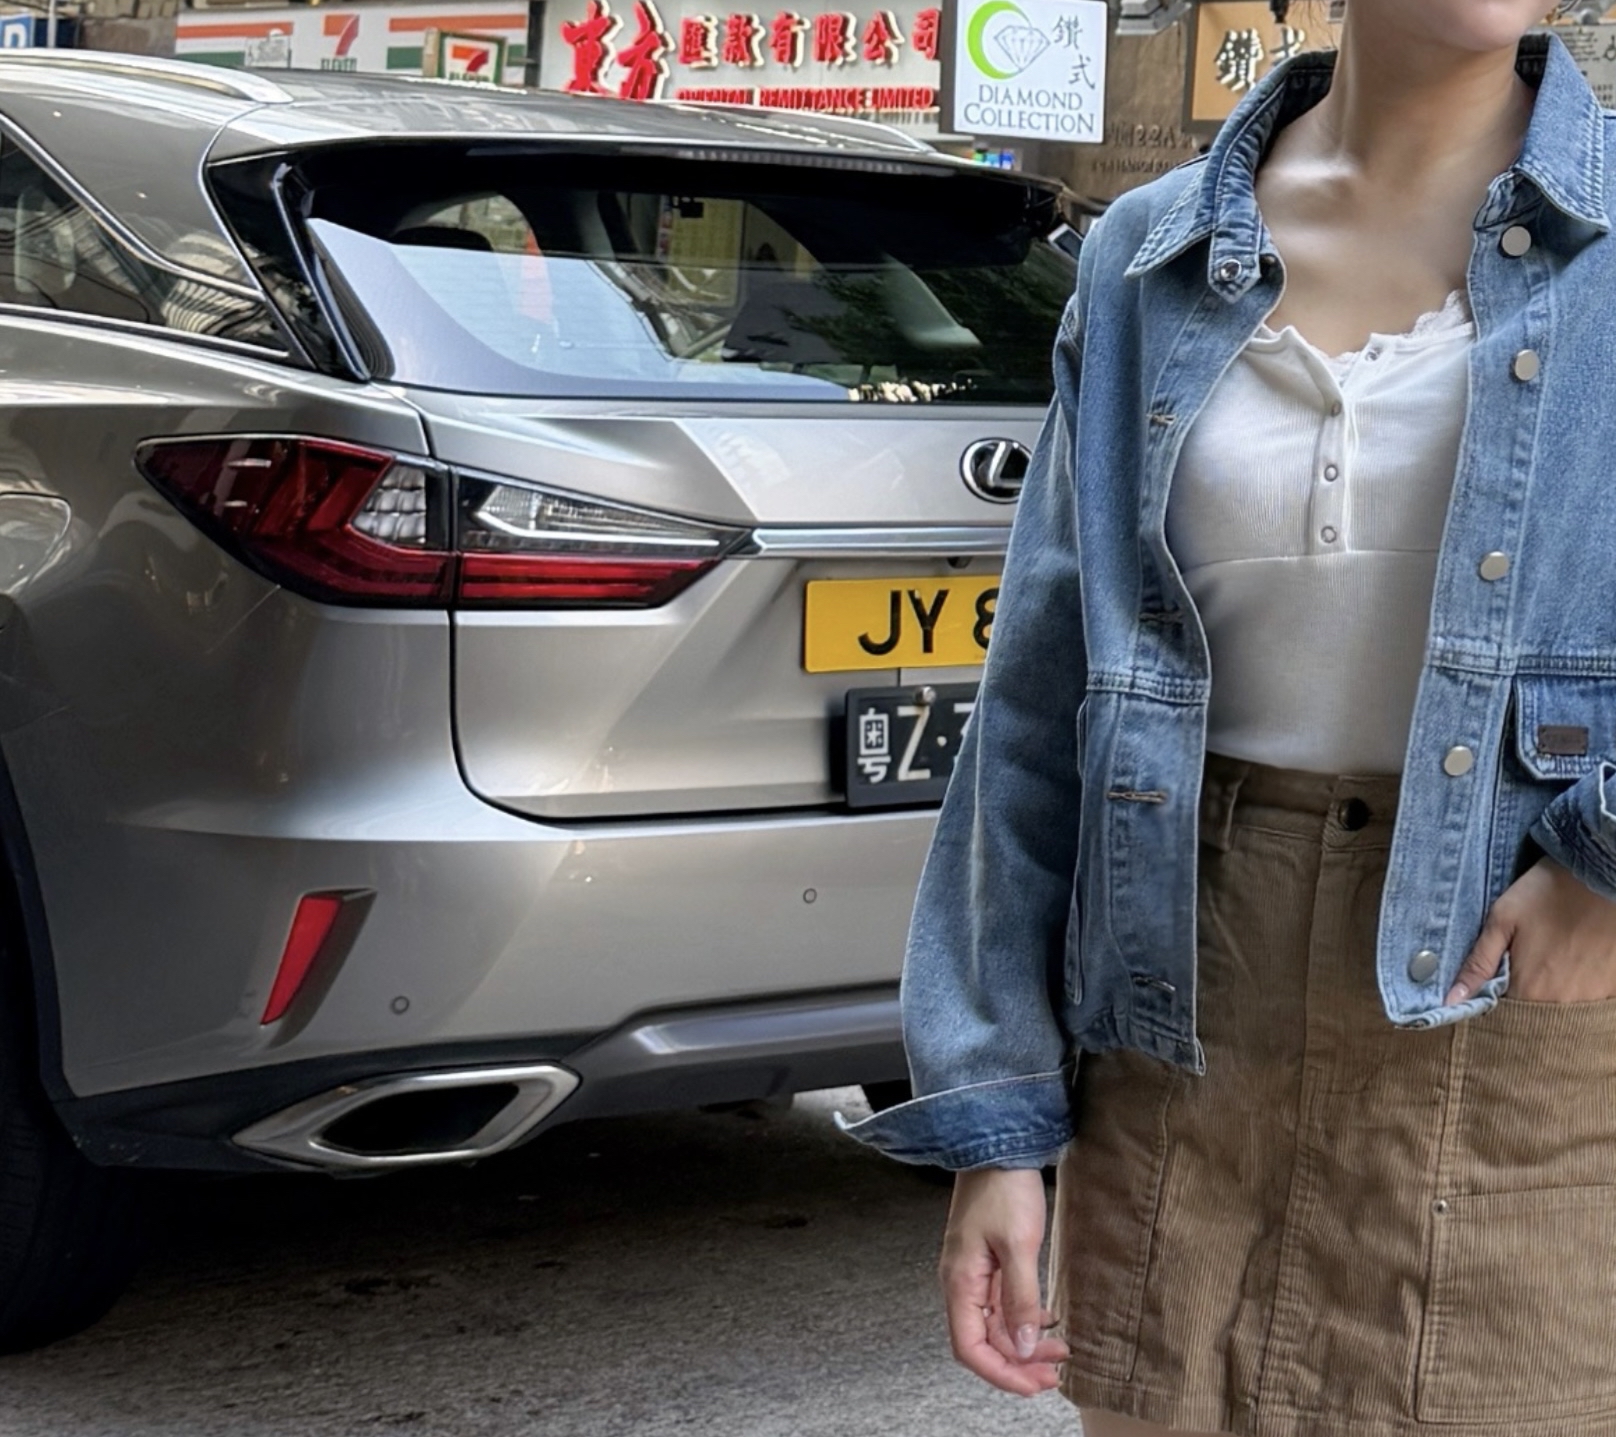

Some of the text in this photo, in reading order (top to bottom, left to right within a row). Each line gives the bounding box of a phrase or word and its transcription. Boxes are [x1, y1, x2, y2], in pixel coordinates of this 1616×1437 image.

[758, 87, 863, 111] REMITTANCE
[870, 87, 934, 110] LIMITED
[978, 83, 1084, 112] DIAMOND
[963, 102, 1096, 135] COLLECTION
[857, 588, 950, 656] JY
